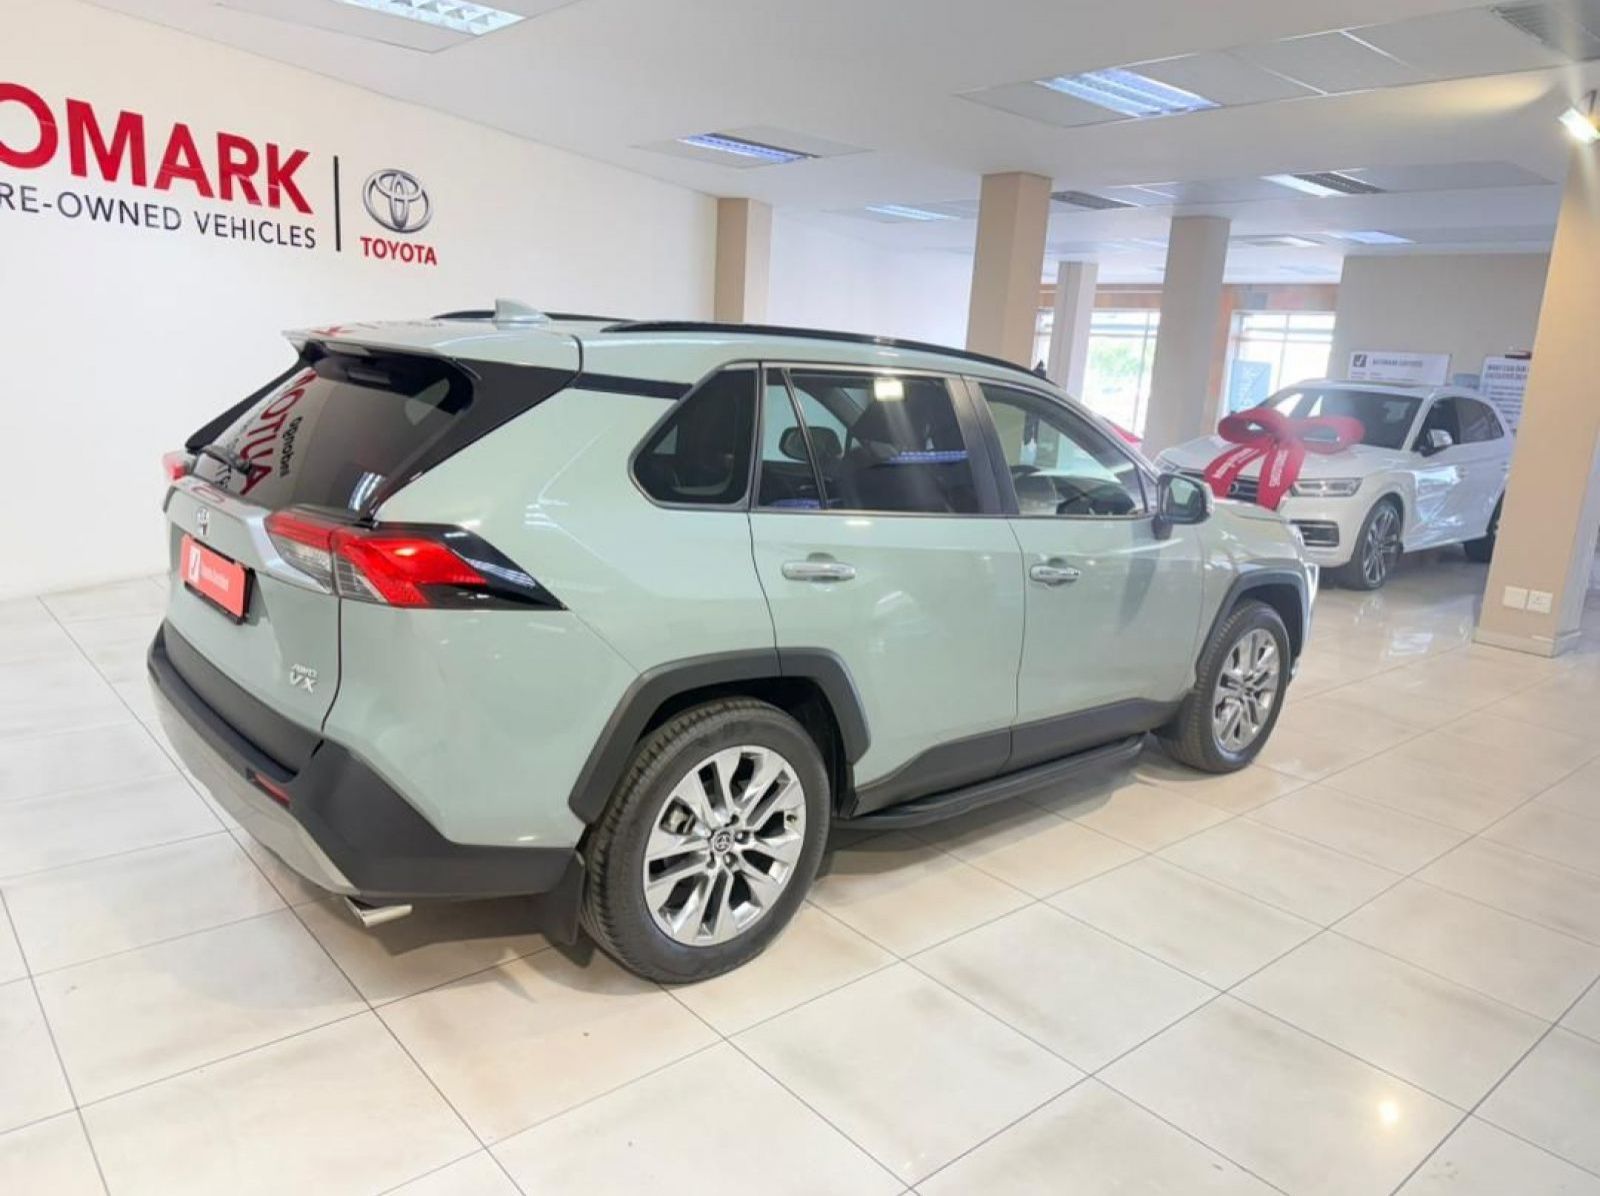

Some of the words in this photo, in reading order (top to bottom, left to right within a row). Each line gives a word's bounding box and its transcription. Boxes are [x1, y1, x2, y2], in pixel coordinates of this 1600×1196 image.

[0, 82, 313, 214] OMARK
[193, 210, 317, 249] VEHICLES
[360, 236, 438, 266] TOYOTA
[290, 670, 317, 693] VX
